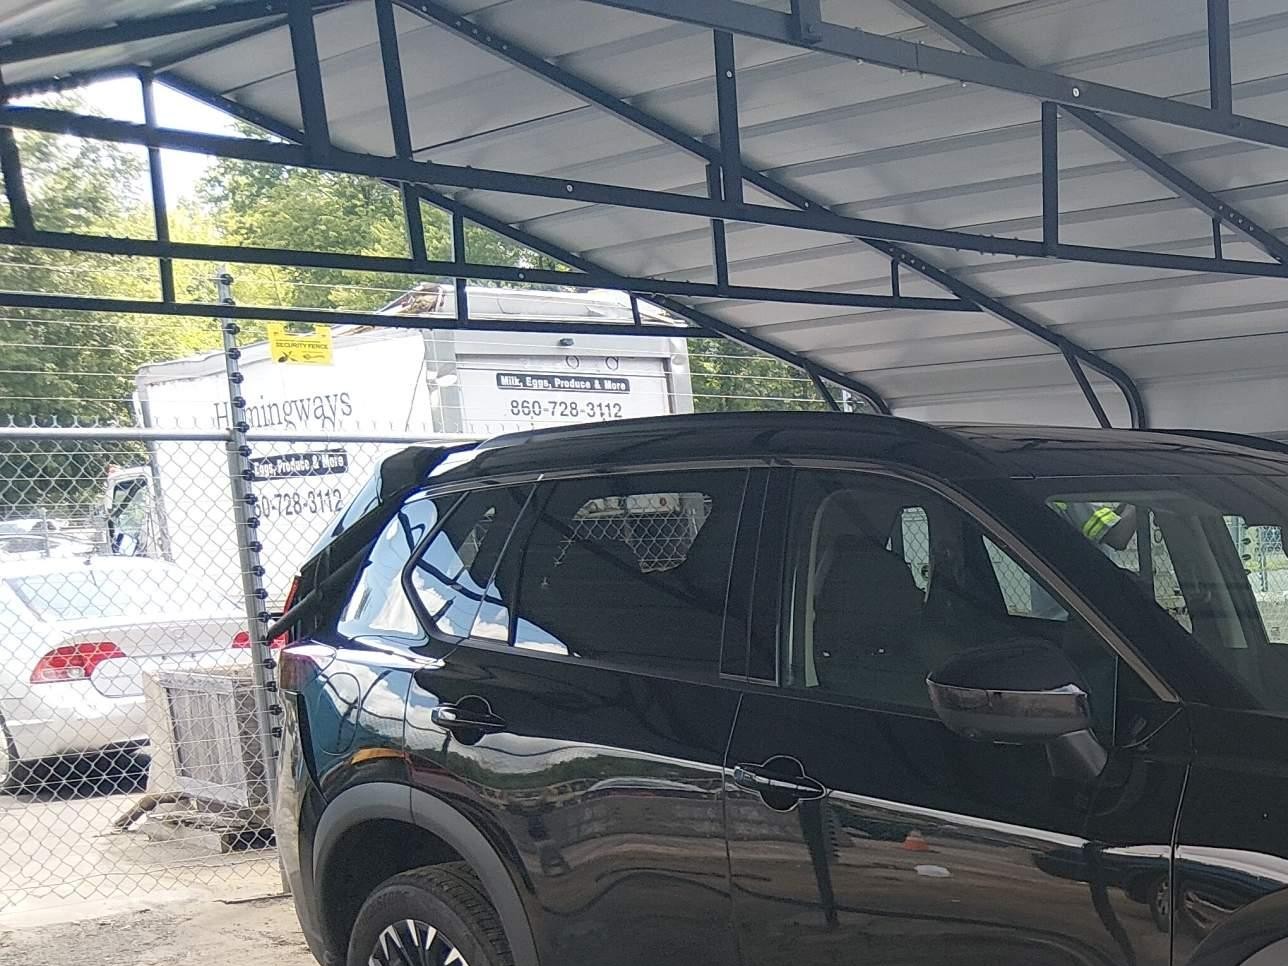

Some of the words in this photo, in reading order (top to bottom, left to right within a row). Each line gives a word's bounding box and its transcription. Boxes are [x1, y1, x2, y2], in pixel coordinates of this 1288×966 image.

[500, 375, 523, 388] Milk,
[525, 376, 552, 389] Eggs,
[554, 377, 592, 389] Produce
[594, 379, 602, 389] &
[603, 380, 626, 390] More
[213, 392, 352, 432] Hmingways
[510, 399, 623, 418] 860-728-3112
[254, 488, 343, 518] 0-728-3112
